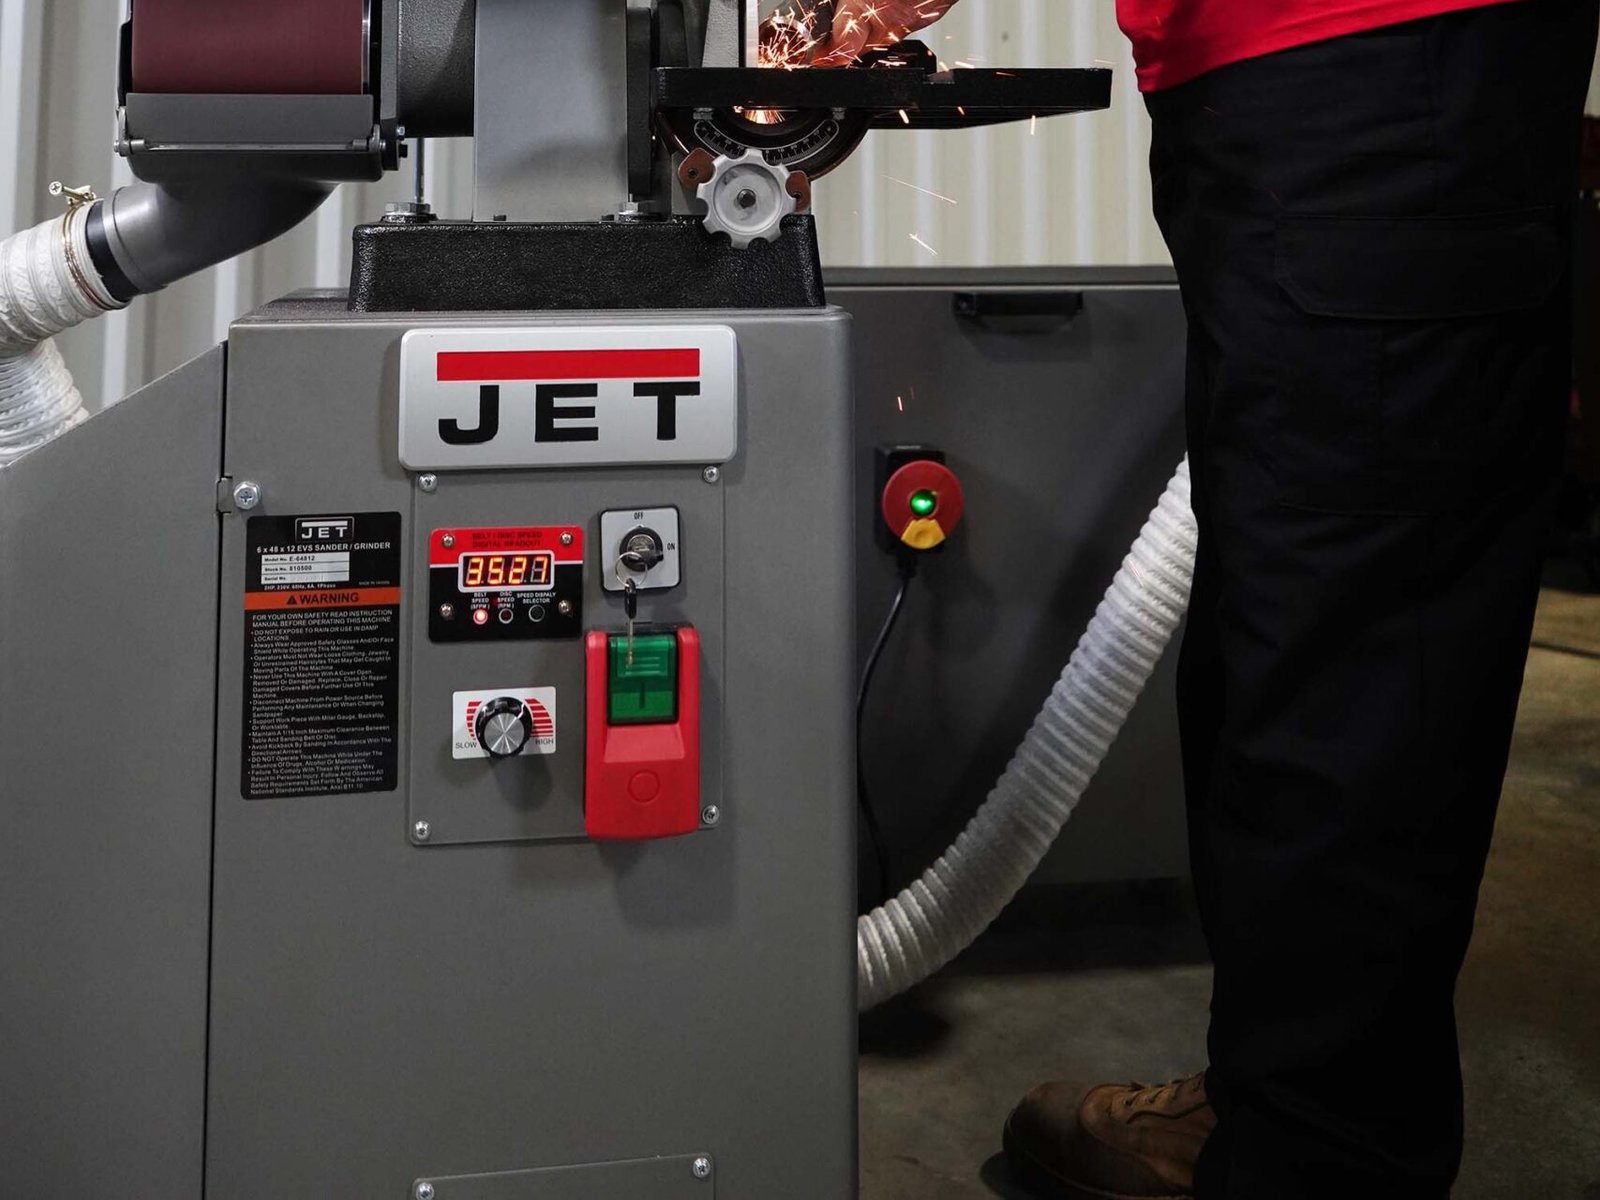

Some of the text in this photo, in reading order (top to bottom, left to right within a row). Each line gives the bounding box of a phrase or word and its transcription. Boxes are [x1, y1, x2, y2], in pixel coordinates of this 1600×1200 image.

[437, 381, 701, 445] JET
[301, 526, 348, 539] JET
[269, 546, 279, 554] 48
[287, 545, 296, 553] 12
[297, 545, 313, 553] EVS
[314, 543, 349, 552] SANDER
[354, 541, 391, 550] GRINDER
[466, 556, 549, 585] 3527
[299, 593, 360, 604] WARNING
[267, 613, 287, 621] YOUR
[349, 609, 393, 617] INSTRUCTION
[252, 621, 279, 629] MANUAL
[308, 618, 345, 626] OPERATING
[346, 617, 361, 625] THIS
[361, 616, 391, 624] MACHINE
